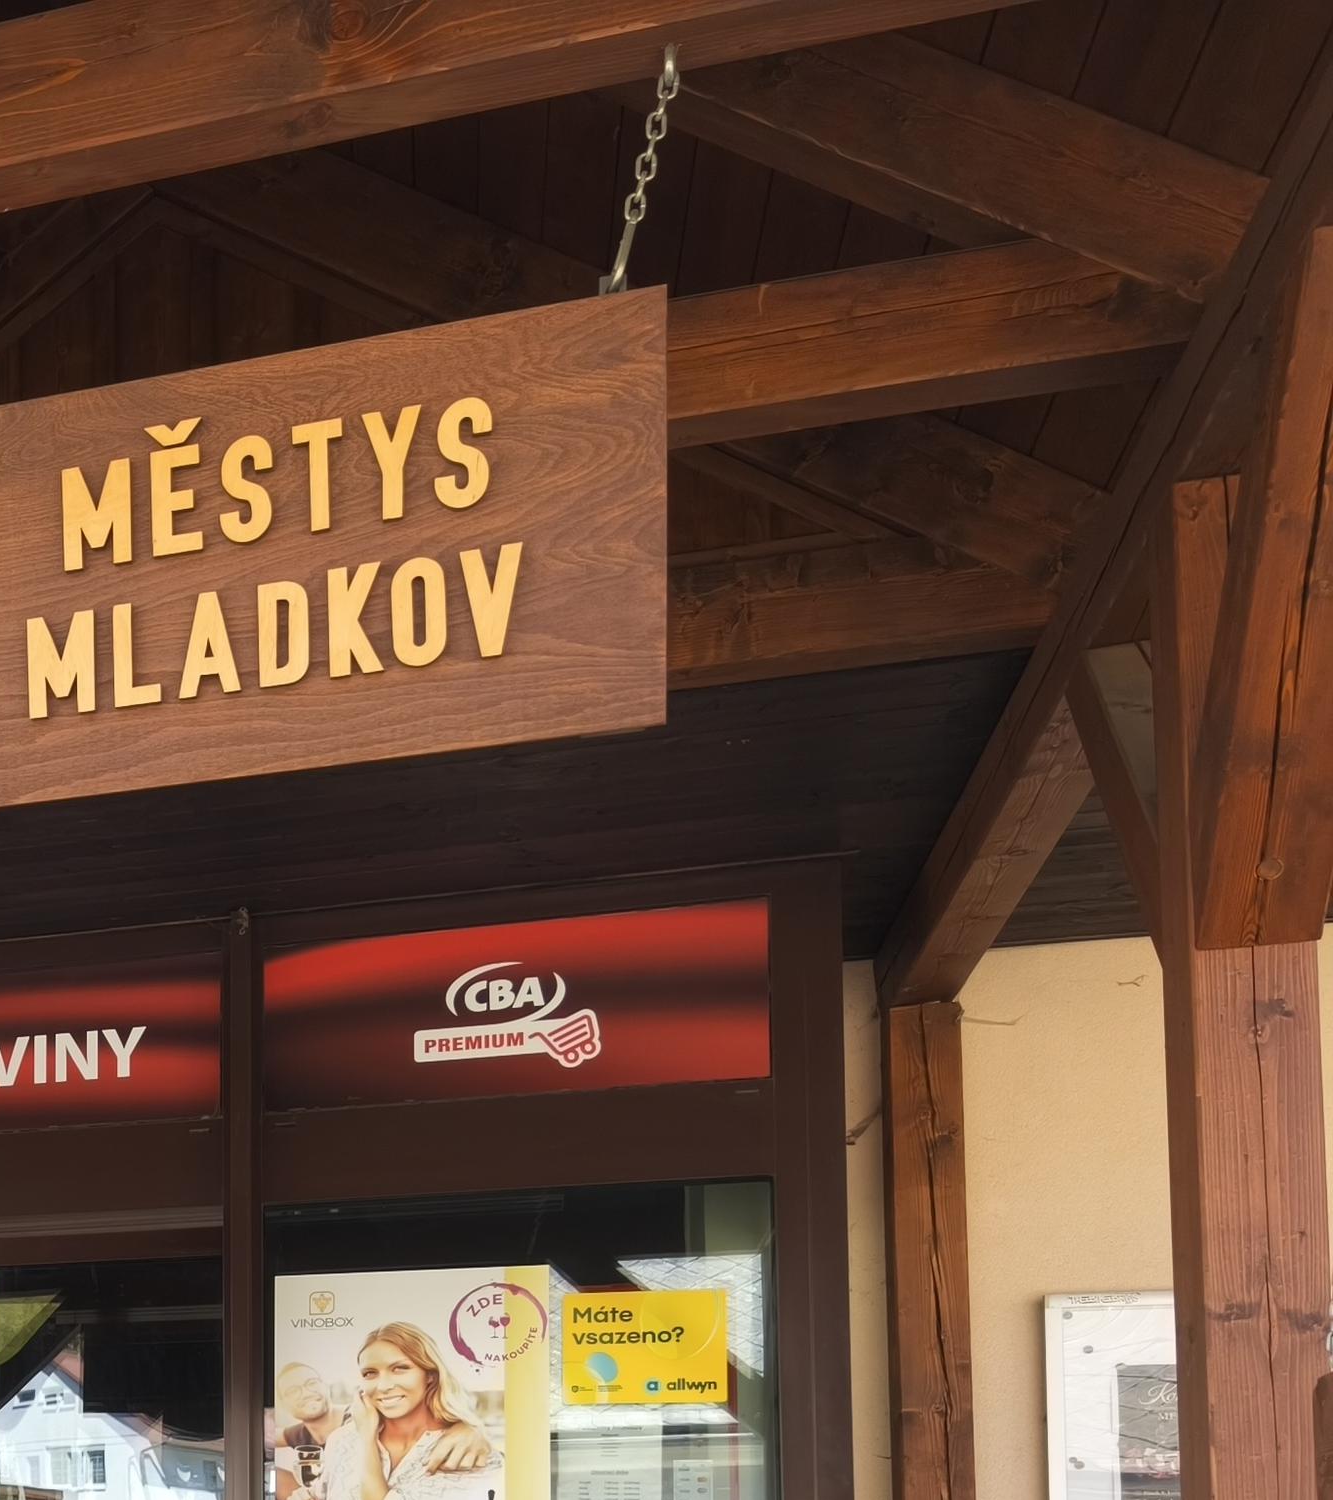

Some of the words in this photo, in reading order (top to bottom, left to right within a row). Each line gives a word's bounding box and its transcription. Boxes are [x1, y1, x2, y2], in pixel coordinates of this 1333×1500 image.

[61, 396, 493, 572] MĚSTYS
[26, 541, 523, 720] MLADKOV
[464, 976, 546, 1013] CBA
[424, 1031, 525, 1054] PREMIUM
[466, 1293, 503, 1318] ZDE
[572, 1305, 634, 1324] Máte
[290, 1316, 354, 1329] VINOBOX
[572, 1326, 685, 1345] vsazeno?
[666, 1378, 718, 1394] allwyn
